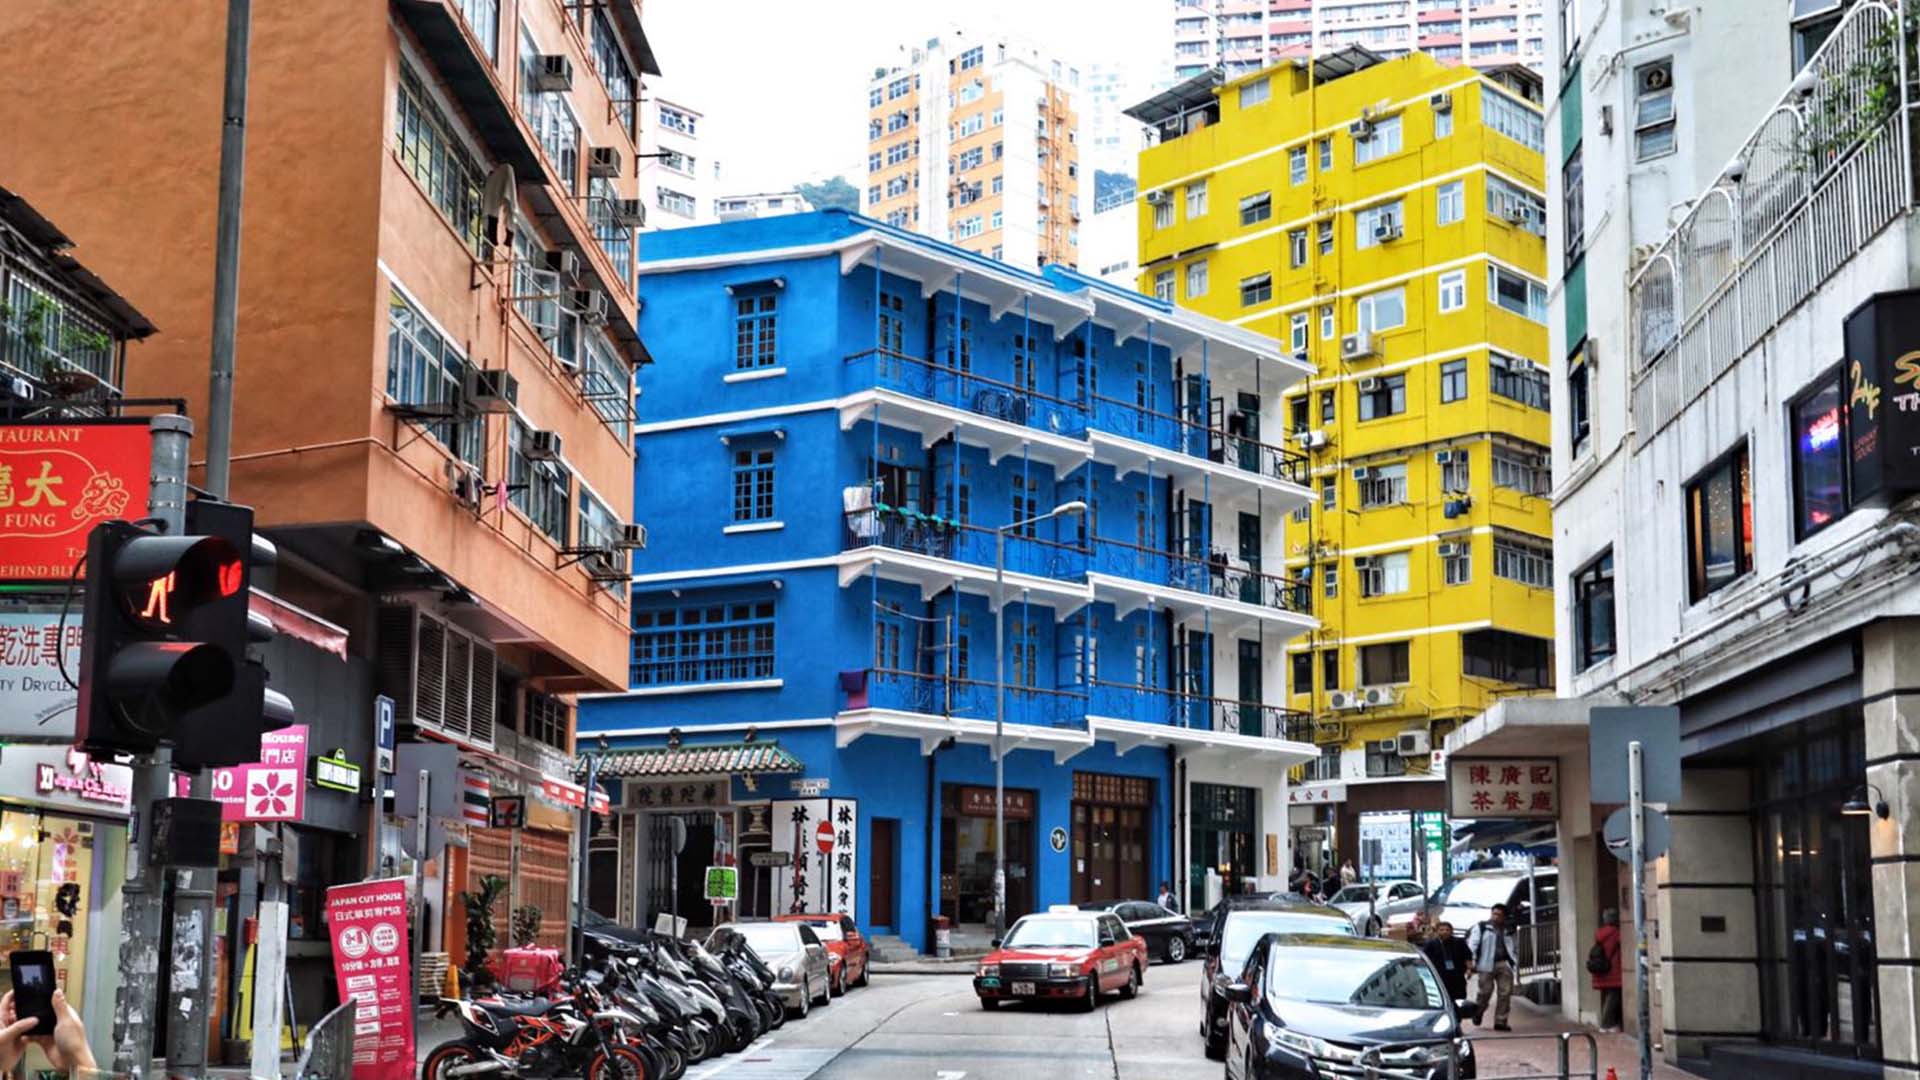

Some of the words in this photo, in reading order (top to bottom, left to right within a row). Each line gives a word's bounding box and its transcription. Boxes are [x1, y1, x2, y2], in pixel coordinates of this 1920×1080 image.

[5, 513, 56, 528] FUNG
[381, 701, 392, 744] P
[261, 748, 297, 764] 門店
[213, 769, 234, 791] 0
[1469, 764, 1553, 786] 陳廣記
[358, 894, 375, 904] CUT
